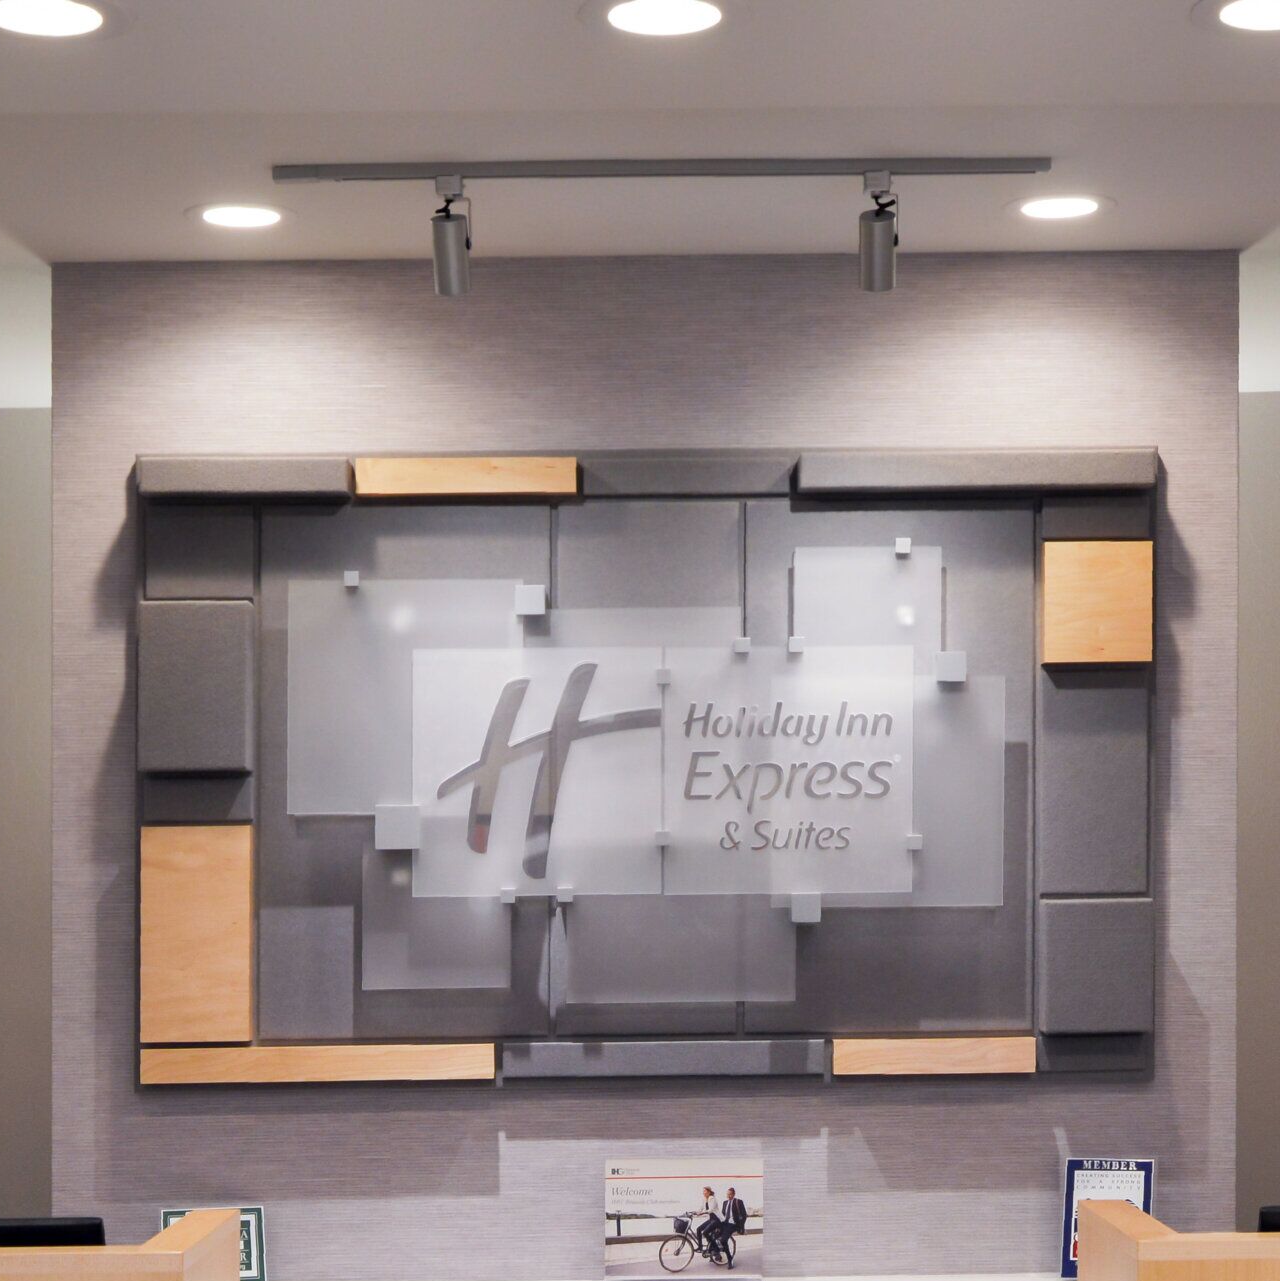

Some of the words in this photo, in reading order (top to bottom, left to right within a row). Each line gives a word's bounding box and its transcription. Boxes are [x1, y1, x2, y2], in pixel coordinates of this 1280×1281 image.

[683, 701, 830, 746] Holiday
[835, 700, 894, 737] Inn
[683, 750, 894, 815] Express
[720, 821, 742, 851] &
[751, 820, 852, 851] Suites
[1083, 1161, 1137, 1170] MEMBER
[611, 1186, 654, 1197] Welcome
